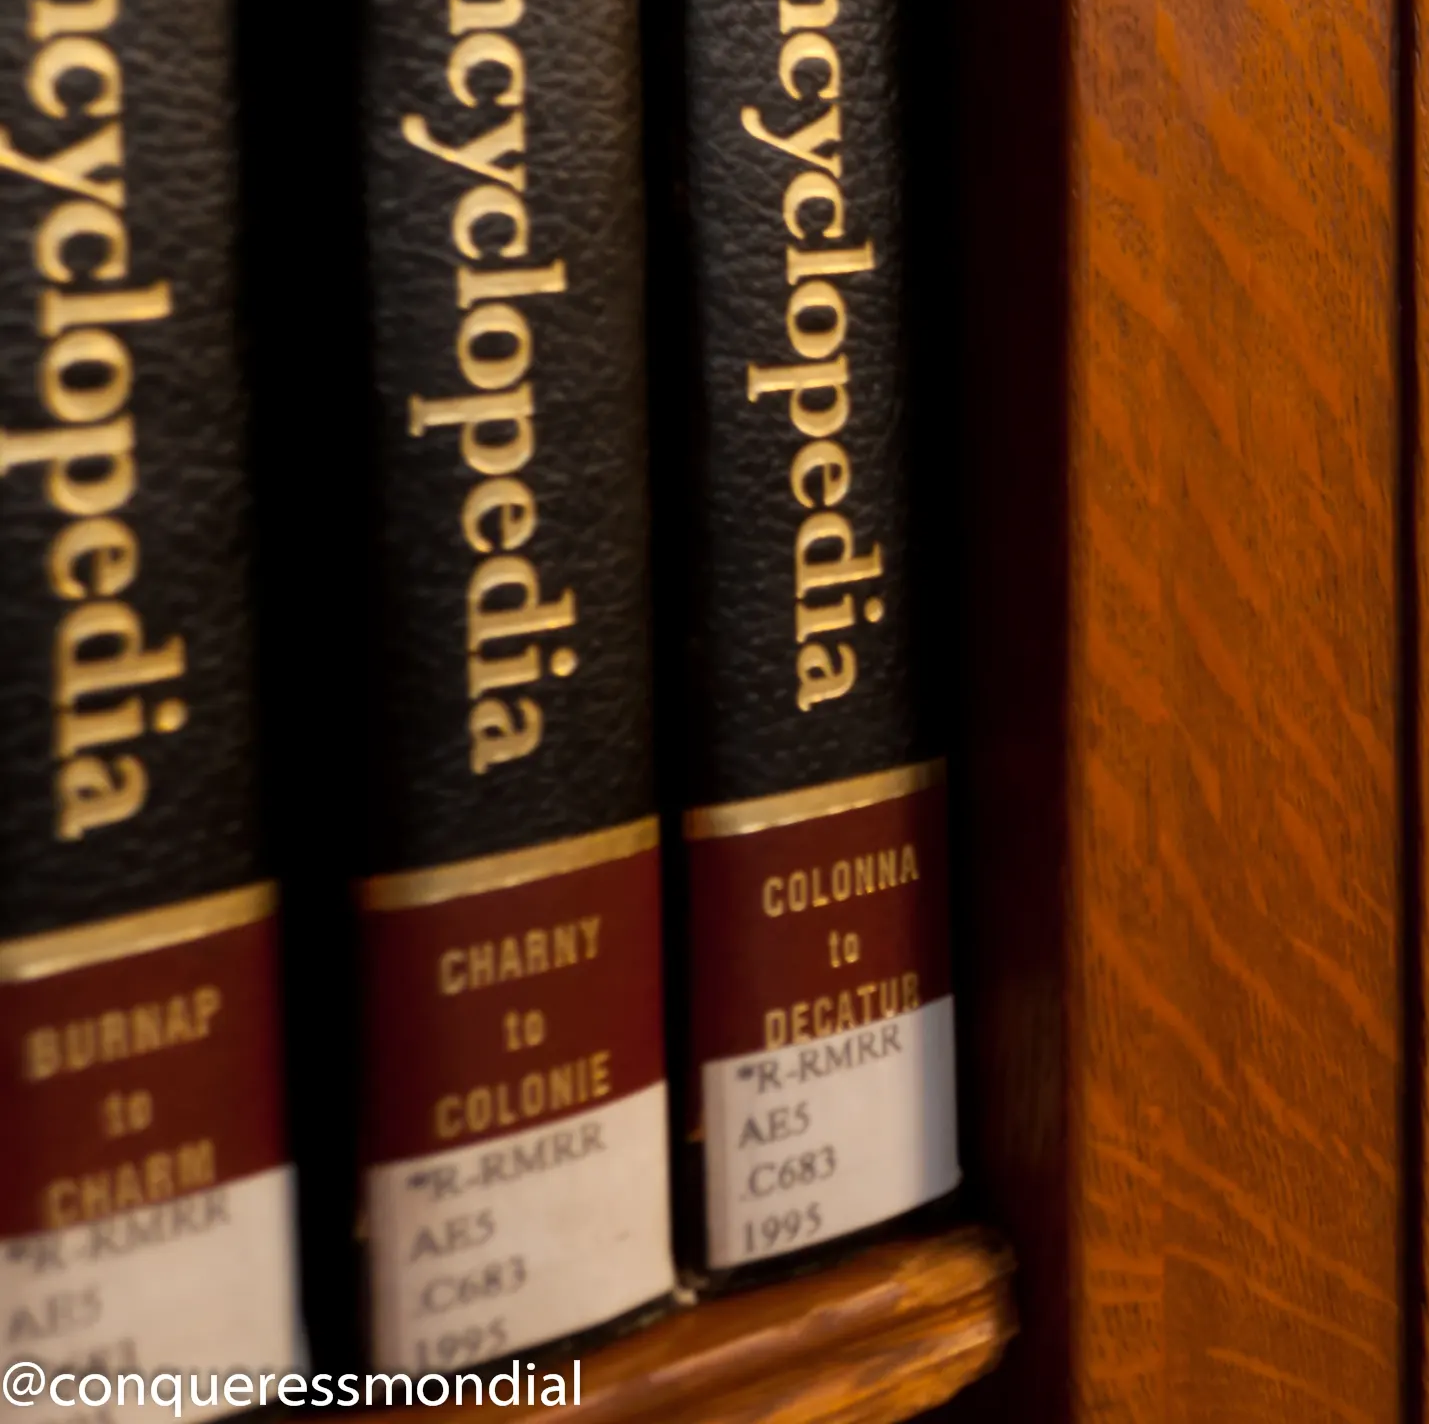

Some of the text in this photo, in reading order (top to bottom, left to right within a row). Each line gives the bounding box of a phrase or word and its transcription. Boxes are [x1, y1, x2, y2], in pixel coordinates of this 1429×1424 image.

[762, 843, 921, 919] COLONNA
[437, 913, 604, 997] CHARNY
[828, 928, 862, 969] to
[25, 983, 224, 1083] BURNAP
[503, 1007, 547, 1053] to
[763, 971, 921, 1052] DECATUR
[433, 1048, 614, 1141] COLONIE
[738, 1101, 814, 1150] AE5
[744, 1200, 825, 1255] 1995
